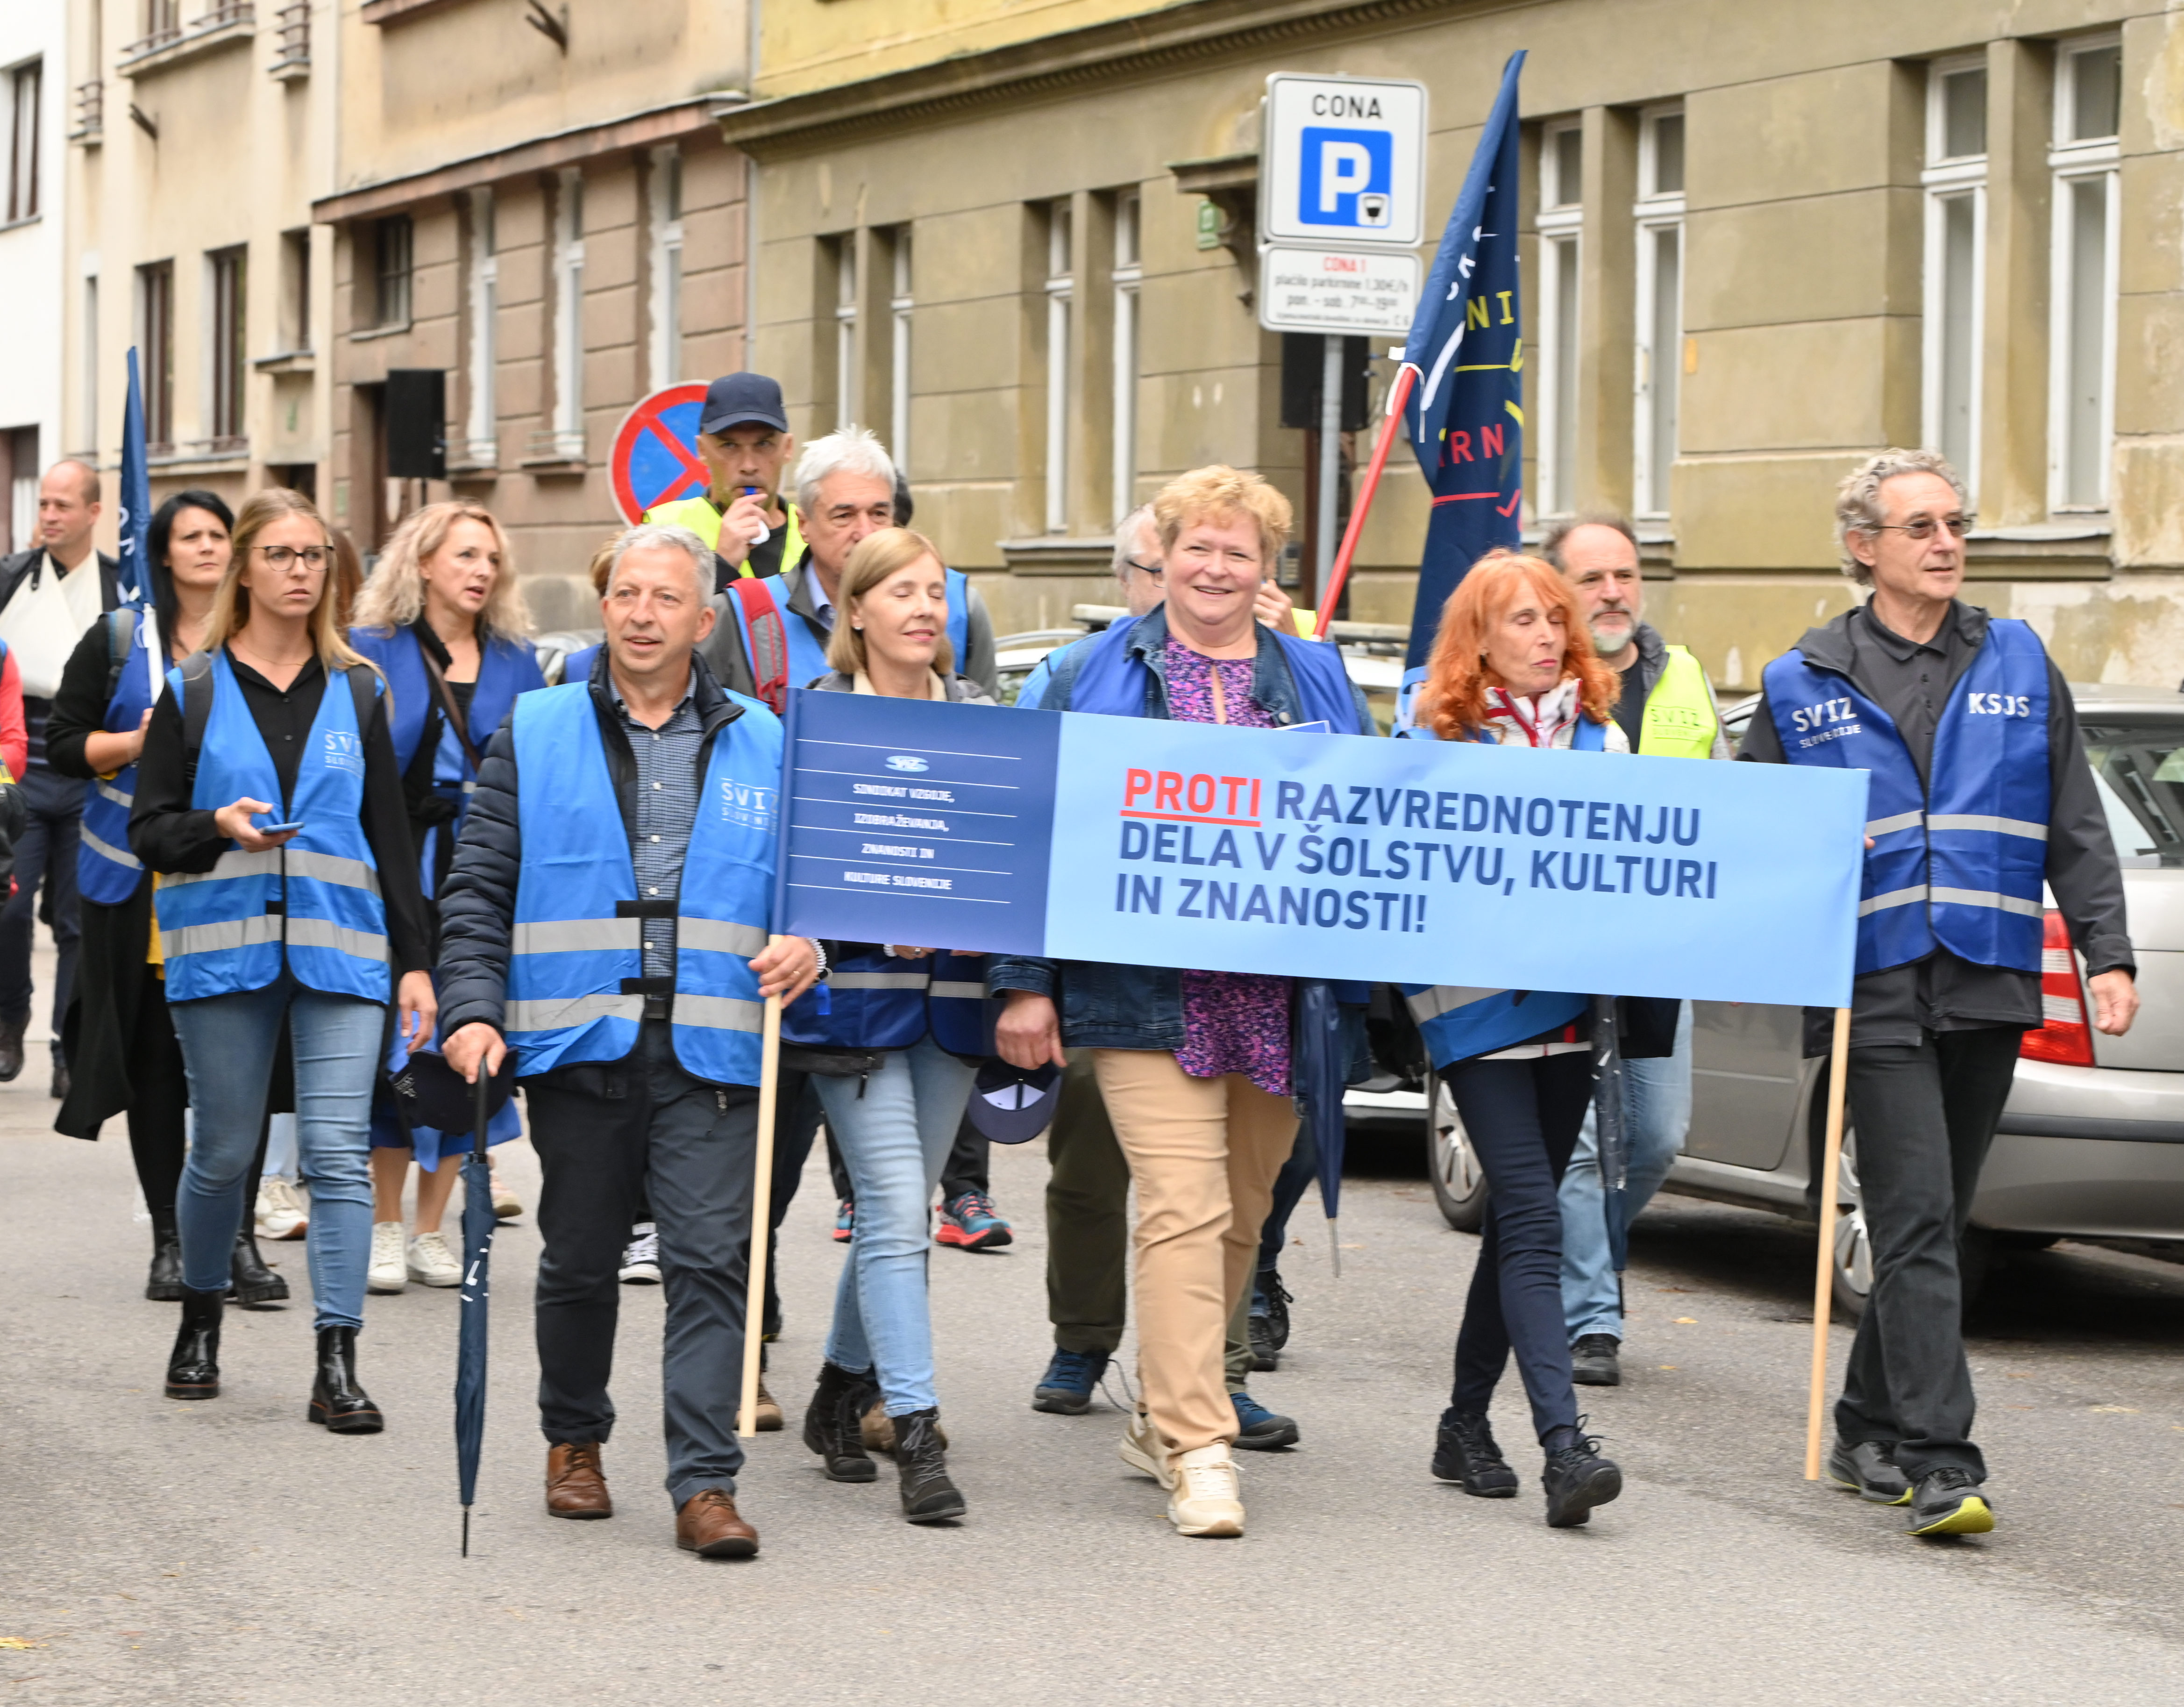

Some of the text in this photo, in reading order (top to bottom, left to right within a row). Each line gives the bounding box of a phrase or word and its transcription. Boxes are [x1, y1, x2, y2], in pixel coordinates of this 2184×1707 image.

[1312, 94, 1383, 119] CONA
[1319, 141, 1372, 212] P
[1323, 257, 1357, 272] CONA
[1650, 708, 1700, 726] SVIZ
[1791, 697, 1858, 732] SVIZ
[1968, 693, 2030, 718] KSJS
[324, 734, 363, 757] SVI
[1124, 768, 1700, 846] PROTI RAZVREDNOTENJU
[1119, 821, 1717, 899] DELA V ŠOLSTVU, KULTURI
[1115, 873, 1427, 933] IN ZNANOSTI!
